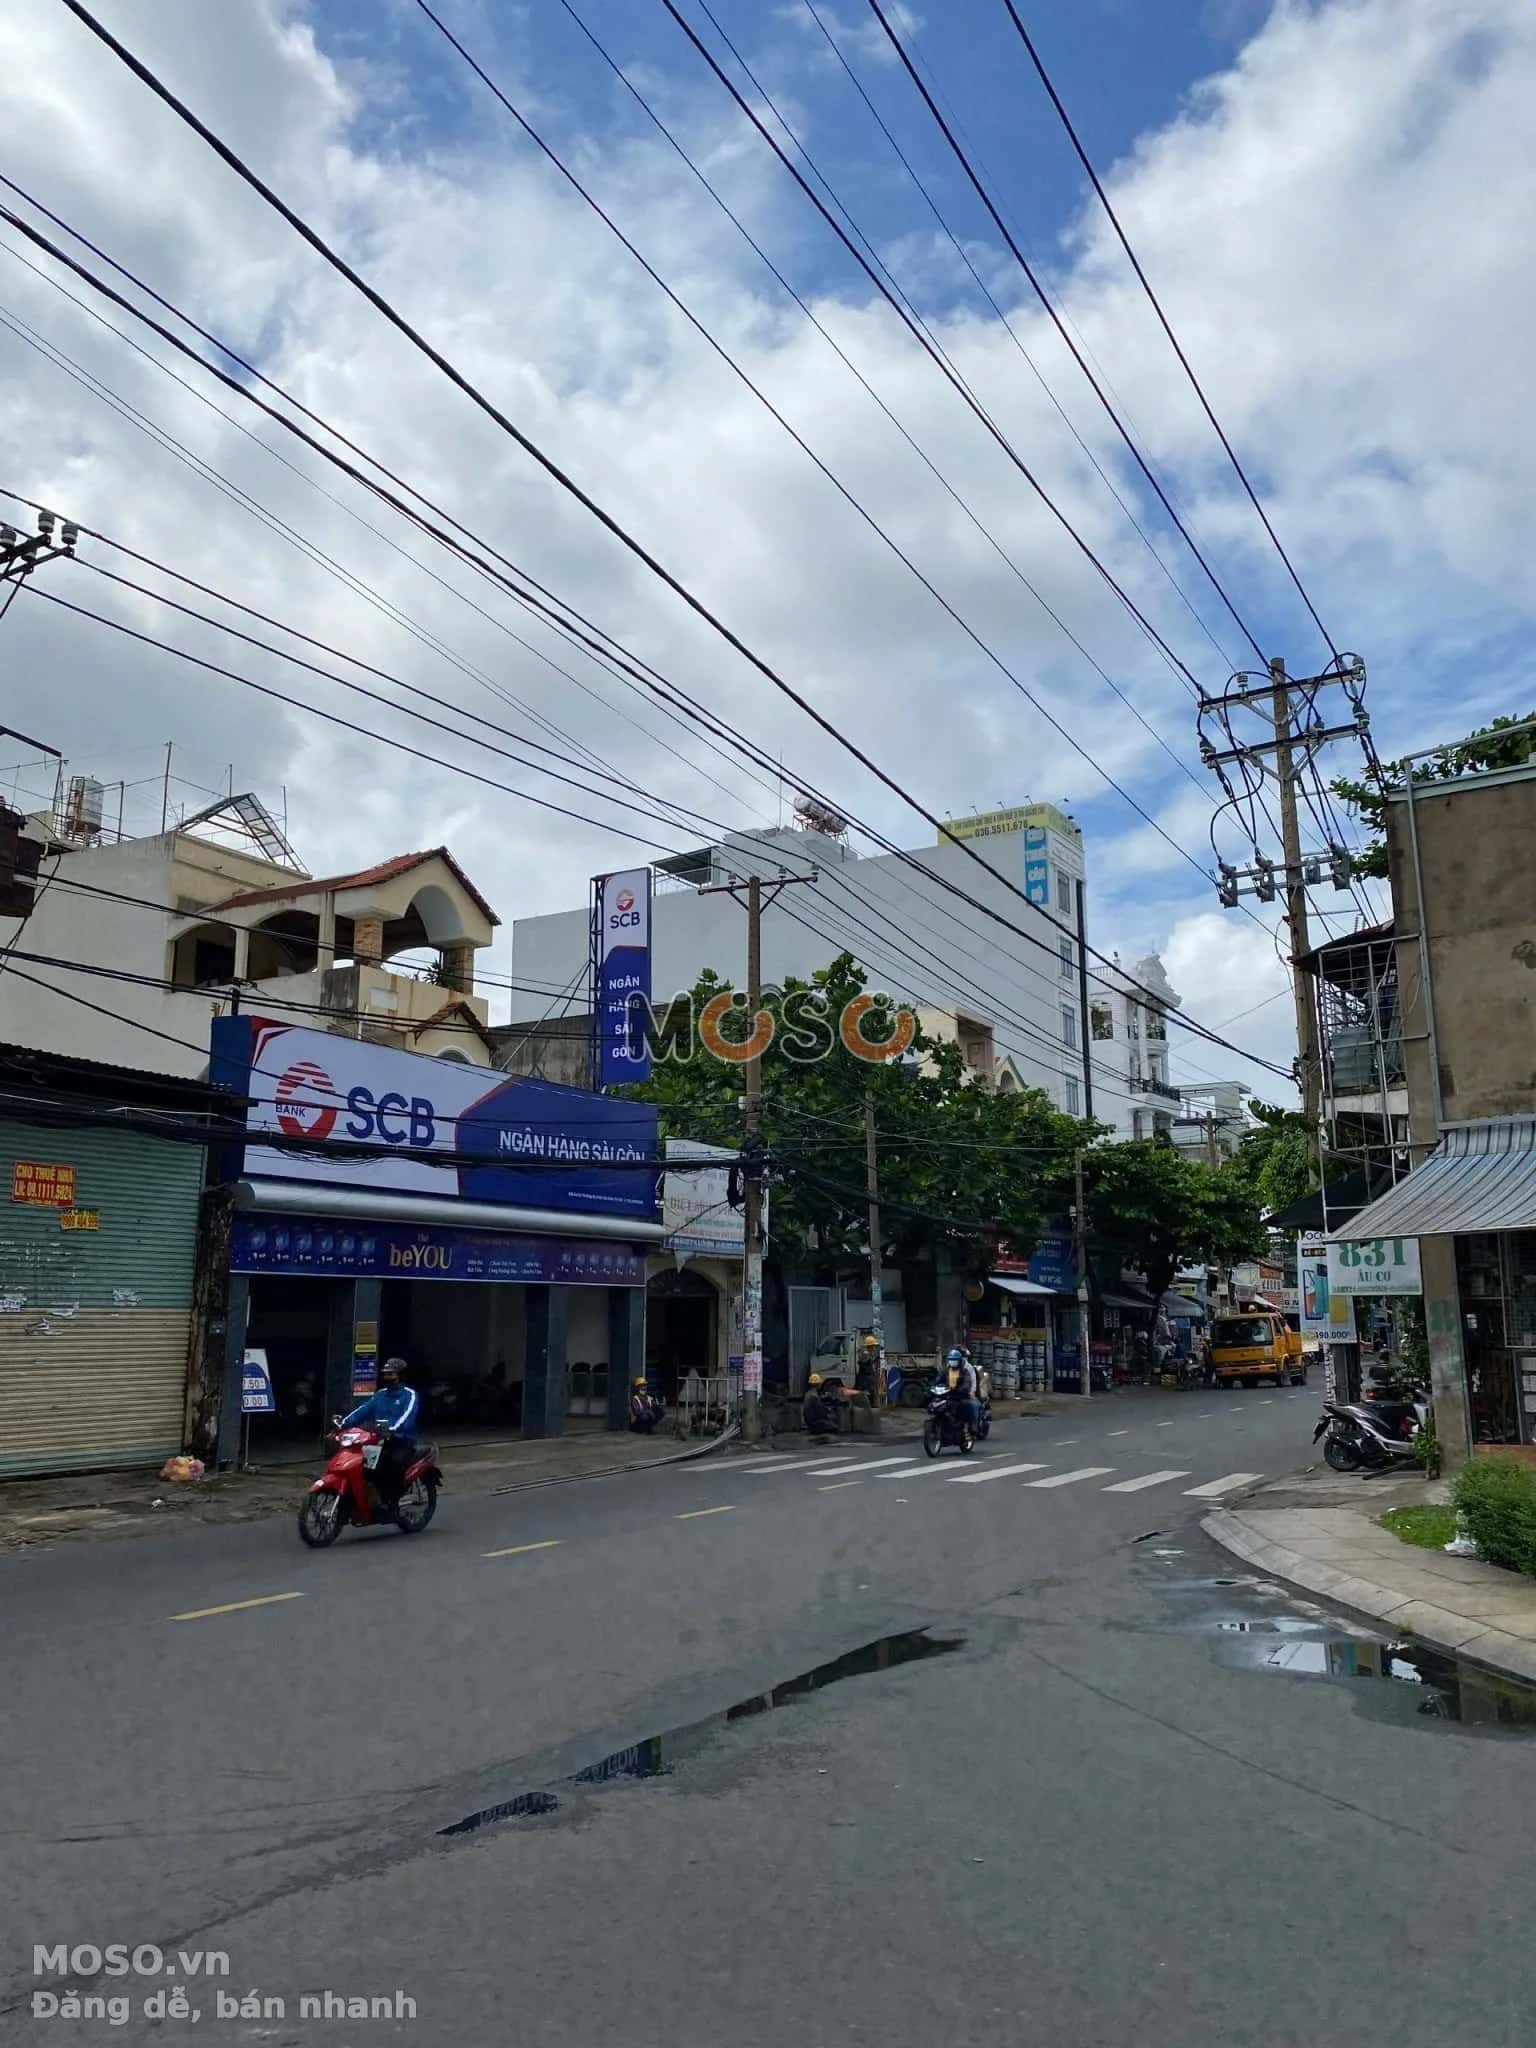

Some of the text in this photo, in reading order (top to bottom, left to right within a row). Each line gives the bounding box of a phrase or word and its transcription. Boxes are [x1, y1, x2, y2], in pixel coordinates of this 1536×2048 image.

[610, 911, 641, 929] SCB
[608, 975, 640, 989] NGÂN
[275, 1103, 307, 1118] BANK
[345, 1086, 436, 1147] SCB
[499, 1127, 545, 1155] NGÂN
[547, 1133, 590, 1160] HÀNG
[389, 1243, 452, 1270] beYOU
[1339, 1239, 1407, 1267] 831
